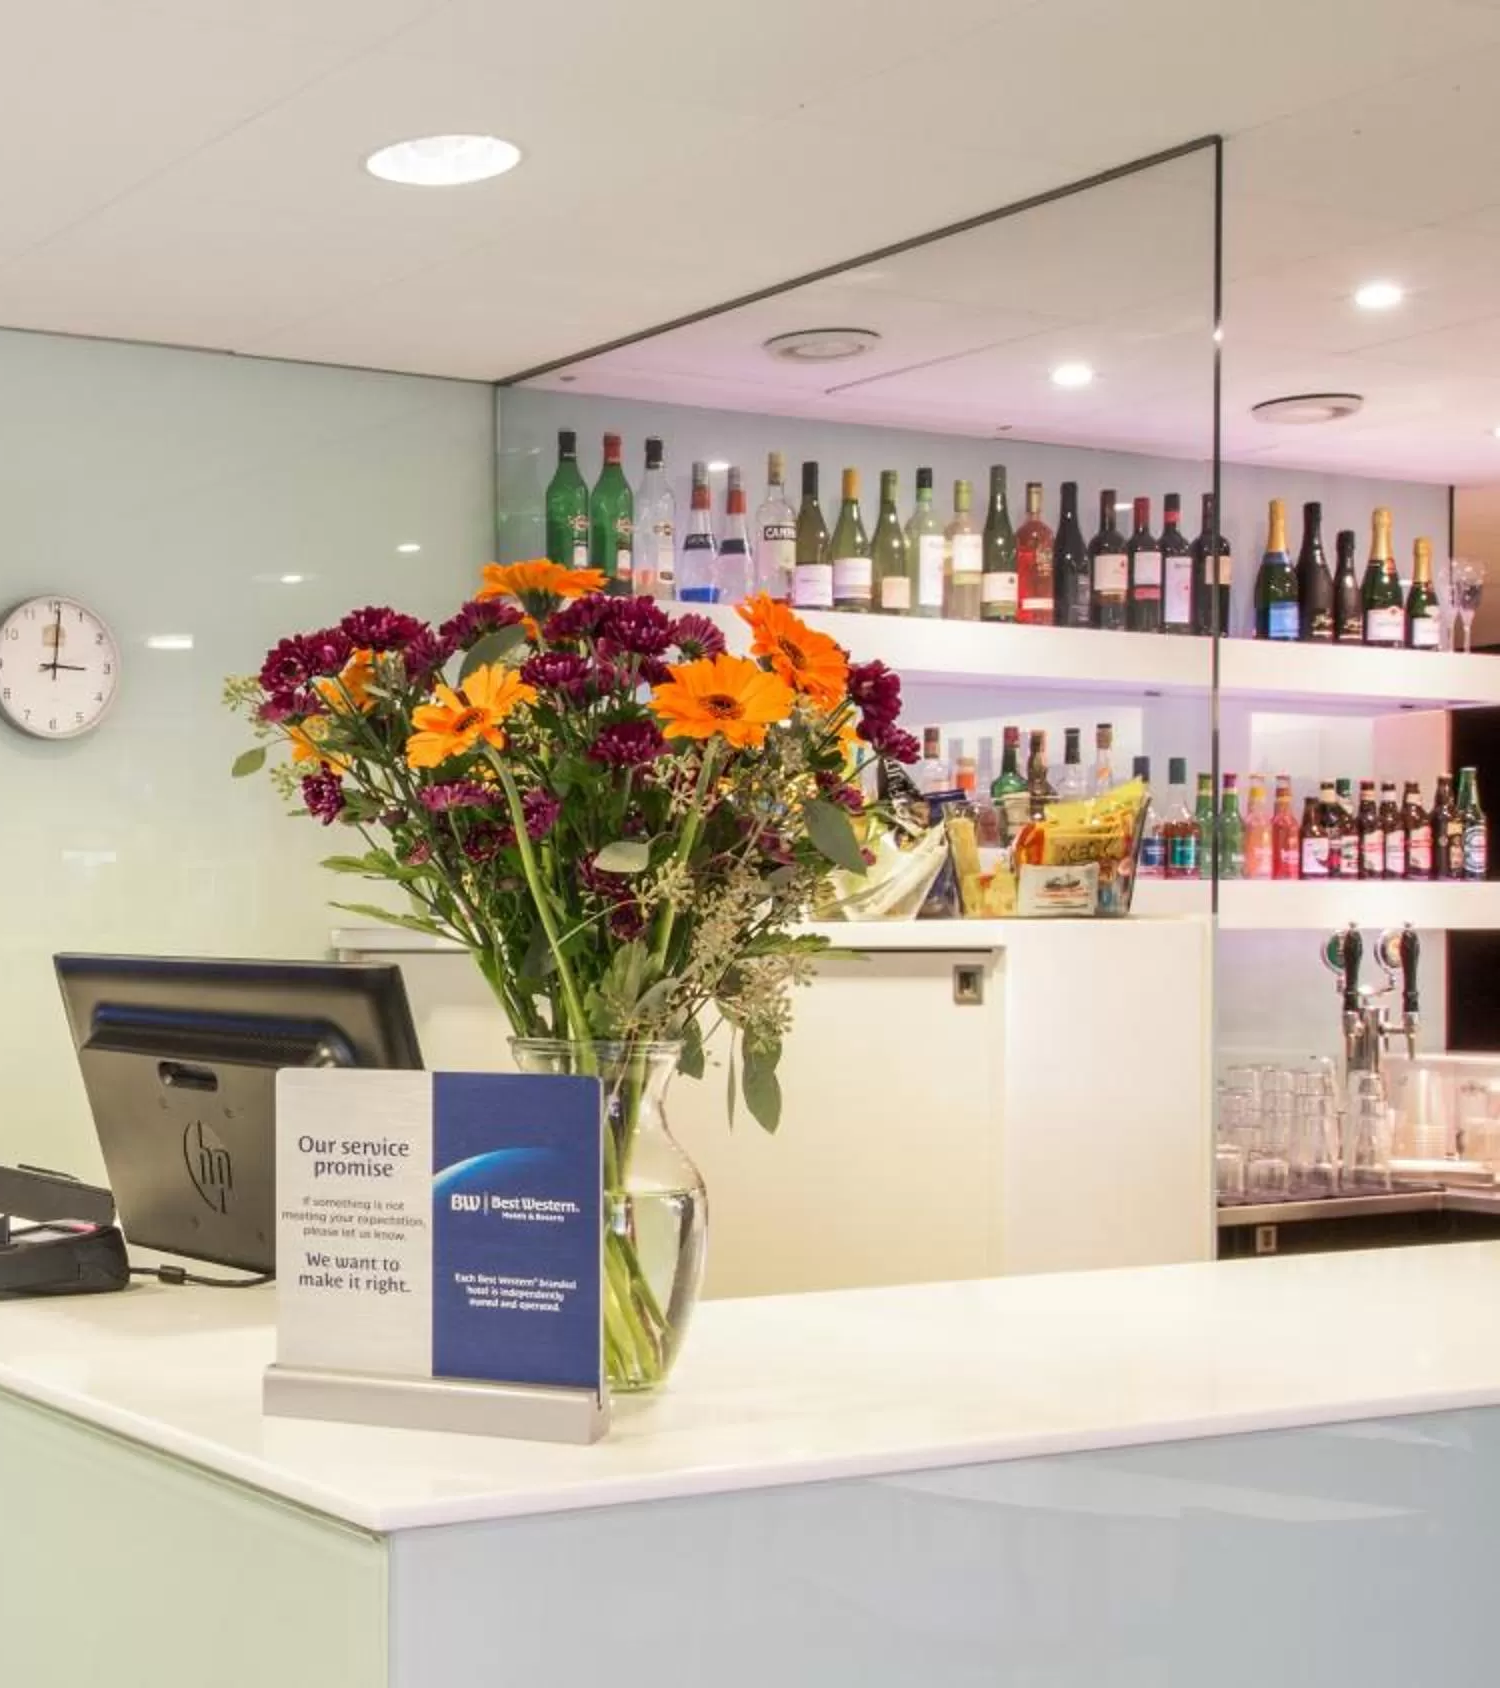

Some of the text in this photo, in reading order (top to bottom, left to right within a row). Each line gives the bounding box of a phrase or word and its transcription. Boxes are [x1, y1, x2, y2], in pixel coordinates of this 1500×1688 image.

[3, 628, 19, 640] 10
[298, 1135, 410, 1157] Our service
[313, 1159, 394, 1178] promise
[312, 1199, 371, 1210] something
[373, 1199, 382, 1210] is
[385, 1201, 404, 1211] not
[451, 1193, 480, 1212] BW
[491, 1195, 520, 1210] Best
[281, 1210, 327, 1222] meeting
[329, 1213, 354, 1224] your
[501, 1211, 527, 1221] Hotels
[535, 1213, 564, 1222] Resorts
[303, 1226, 338, 1237] please
[341, 1227, 355, 1238] let
[359, 1229, 371, 1239] us
[306, 1252, 400, 1272] We want to
[299, 1272, 412, 1295] make it right.
[454, 1273, 476, 1283] Each
[477, 1273, 497, 1285] Best
[466, 1285, 489, 1296] hotel
[500, 1287, 565, 1302] independently
[468, 1298, 498, 1308] owned
[500, 1299, 517, 1309] and
